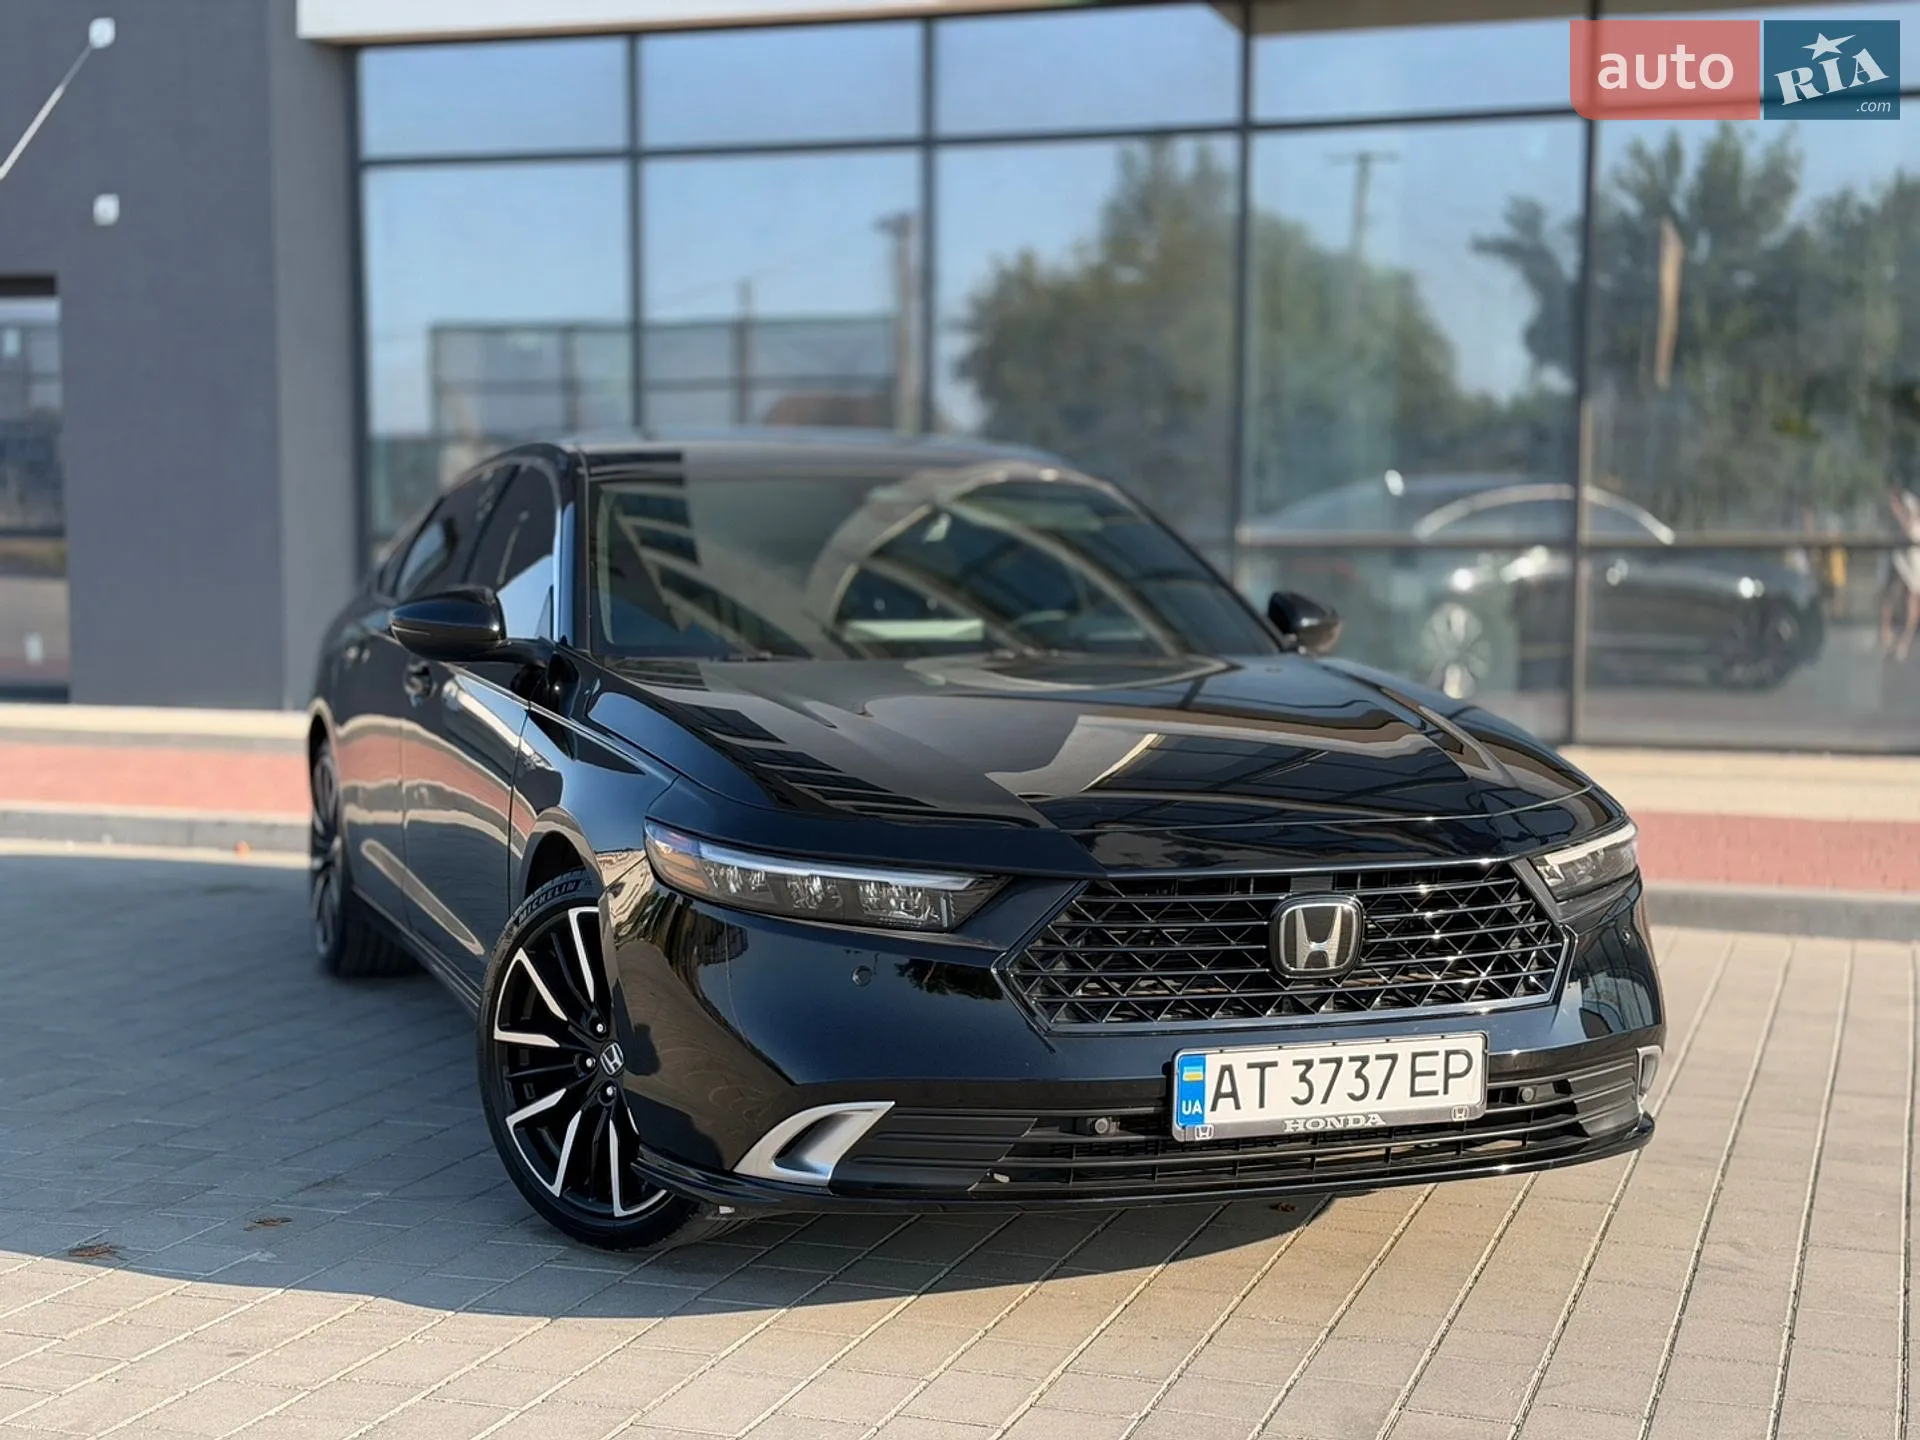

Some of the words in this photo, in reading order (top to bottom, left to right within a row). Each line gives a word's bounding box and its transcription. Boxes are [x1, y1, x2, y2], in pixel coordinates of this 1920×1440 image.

[517, 881, 577, 924] MICHELIN
[1210, 1061, 1279, 1112] AT
[1290, 1053, 1399, 1106] 3737
[1409, 1050, 1473, 1098] EP
[1182, 1100, 1203, 1115] UA
[1284, 1113, 1386, 1132] HONDA
